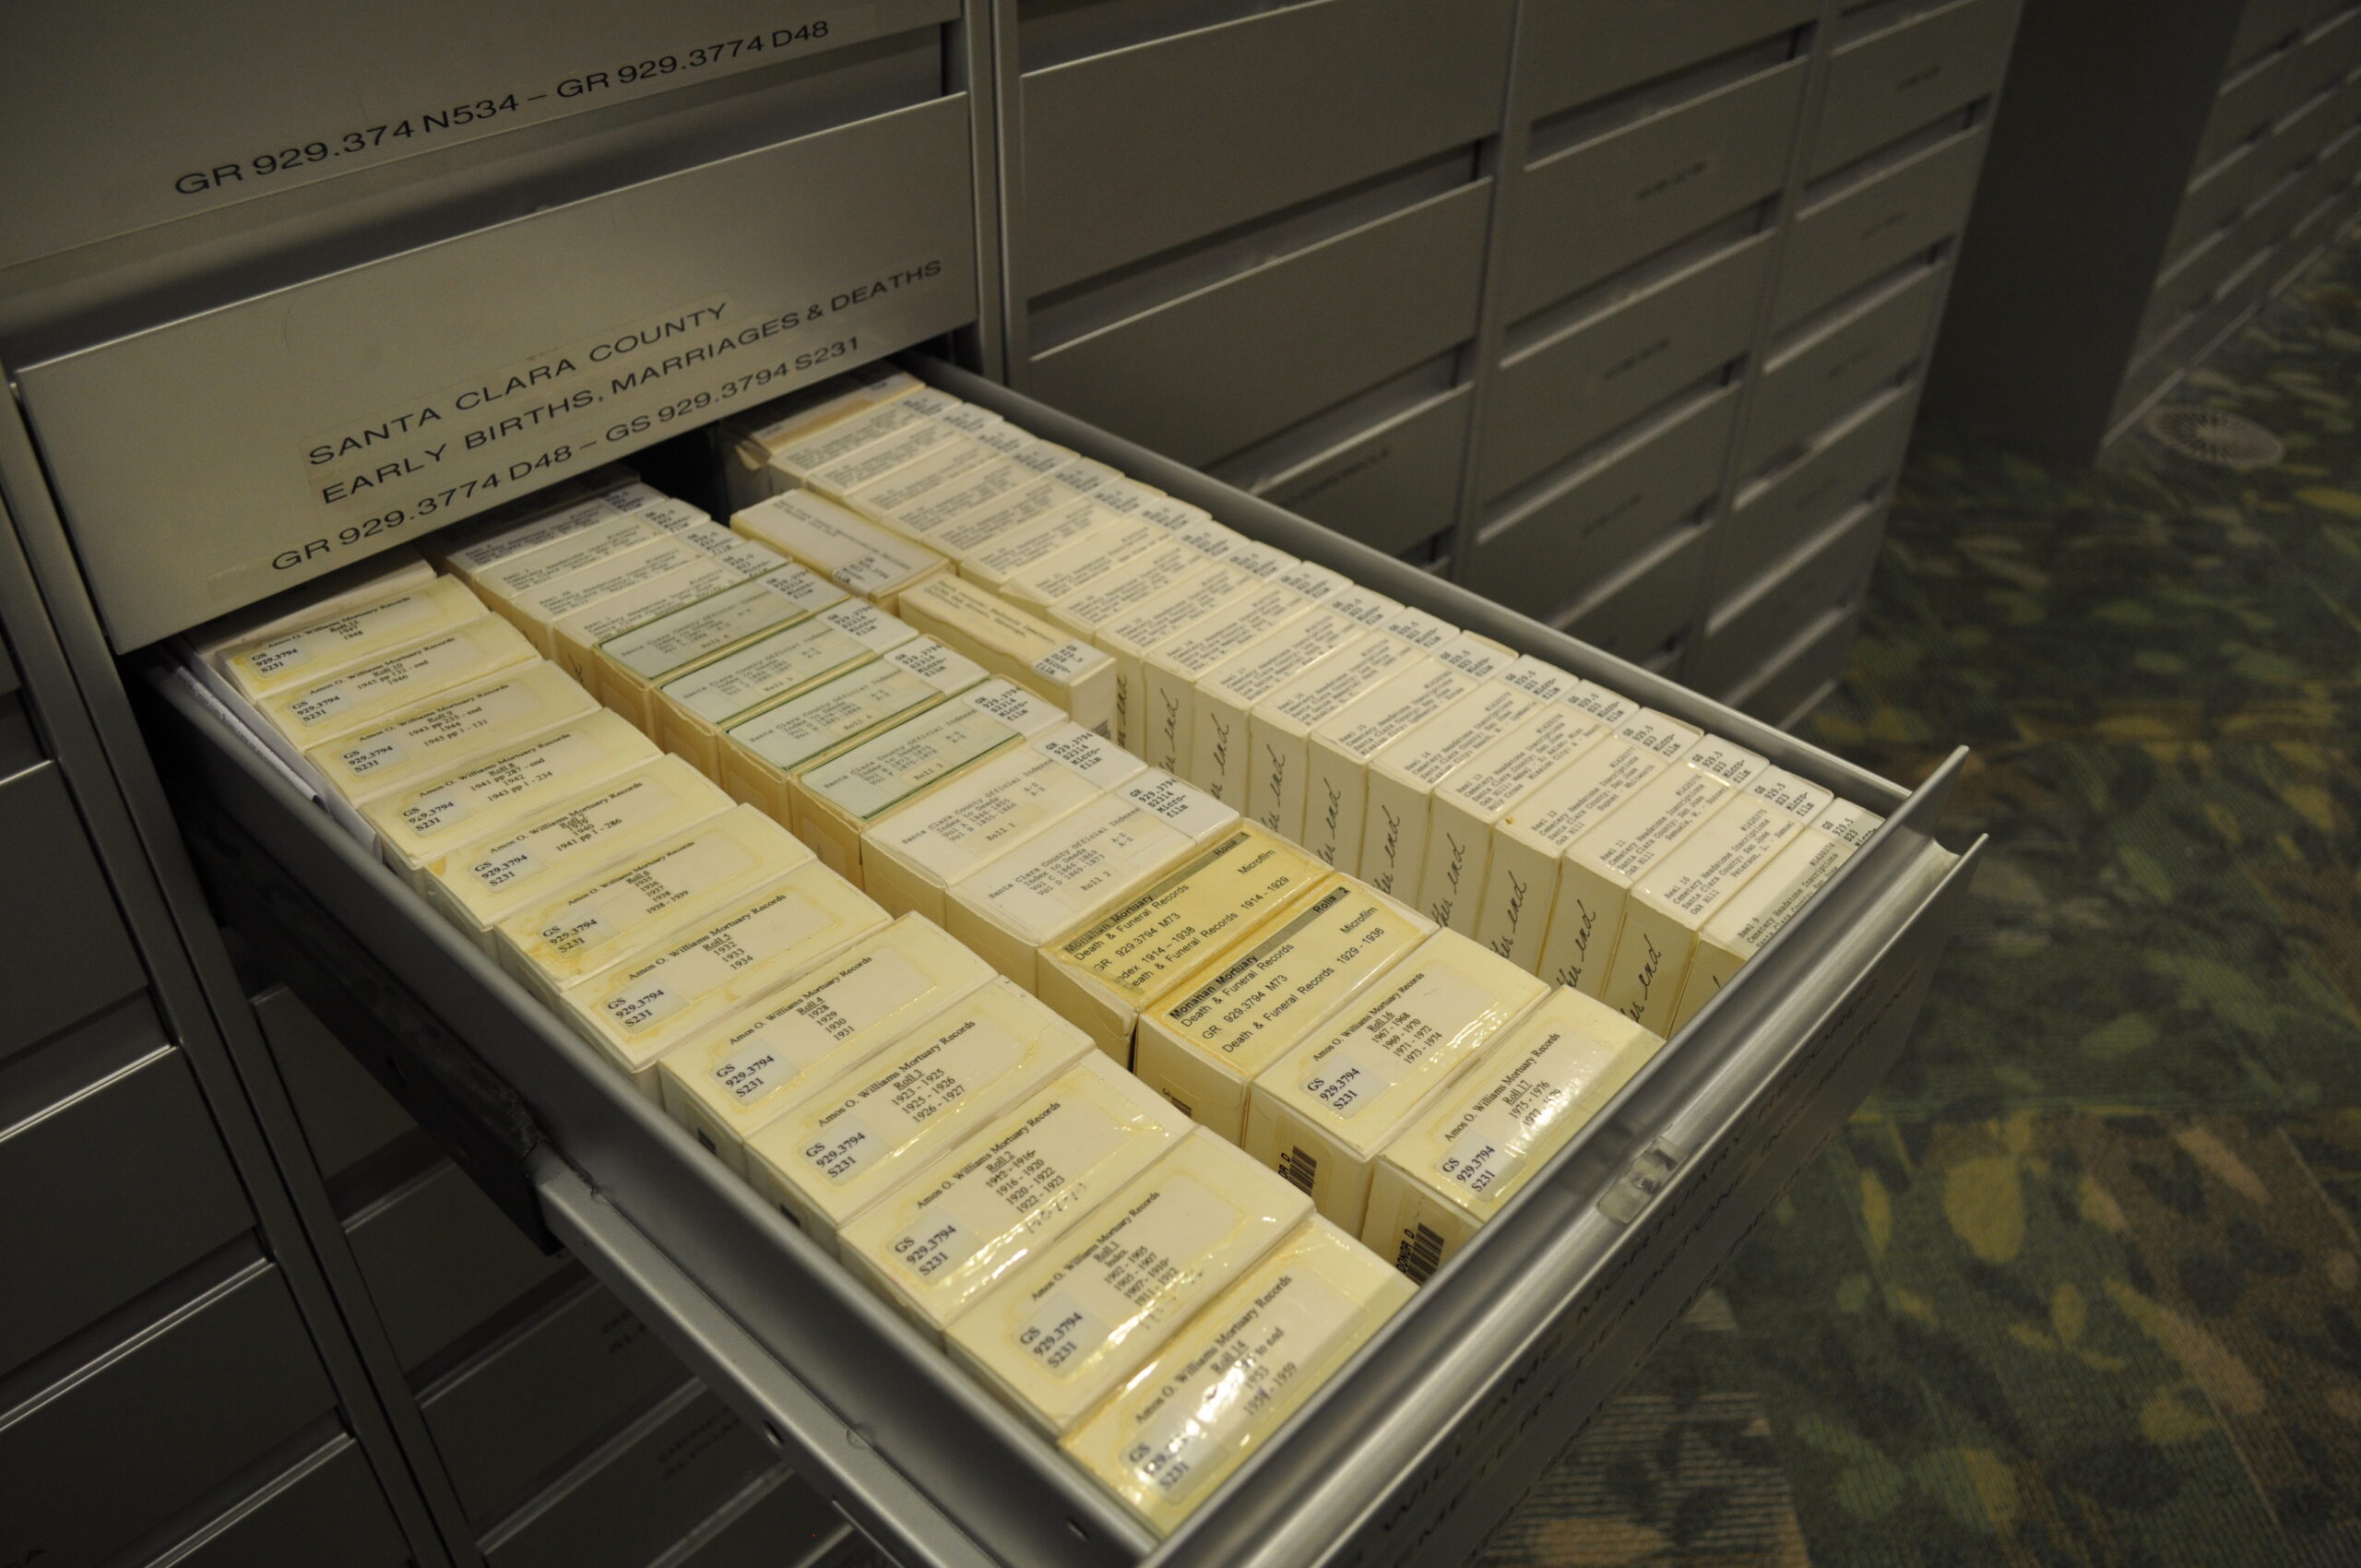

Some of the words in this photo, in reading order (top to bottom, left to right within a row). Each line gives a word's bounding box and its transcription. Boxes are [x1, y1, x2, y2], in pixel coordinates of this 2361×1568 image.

[174, 164, 243, 195] GR
[252, 120, 414, 175] 929.374
[421, 94, 519, 133] N534
[556, 73, 610, 98] GR
[618, 36, 764, 84] 929.3774
[772, 20, 829, 48] D48
[309, 408, 442, 465] SANTA
[456, 359, 576, 411] CLARA
[590, 303, 727, 362] COUNTY
[323, 444, 447, 505] EARLY
[465, 389, 603, 450] BIRTHS,
[611, 313, 800, 394] MARRIAGES
[806, 304, 824, 321] &
[831, 260, 942, 312] DEATHS
[271, 539, 331, 571] GR
[338, 473, 501, 546] 929.3774
[509, 445, 572, 481] D48
[605, 416, 651, 442] GS
[658, 362, 789, 423] 929.3794
[795, 337, 859, 372] S231
[252, 652, 267, 661] GS
[255, 647, 298, 667] 929.3794
[261, 661, 284, 673] S231
[1053, 733, 1094, 755] 929.3794
[1070, 747, 1100, 770] Micro-
[1080, 756, 1102, 772] film
[1129, 788, 1144, 799] GR
[1157, 794, 1187, 814] Micro-
[1785, 791, 1809, 814] Micro-
[1165, 802, 1189, 818] film
[1080, 875, 1102, 893] Roll
[1672, 881, 1703, 907] Cemetery
[1074, 941, 1104, 962] Death
[1108, 932, 1116, 941] &
[1117, 908, 1154, 935] Funeral
[1151, 883, 1190, 911] Records
[1238, 848, 1276, 875] Microfilm
[628, 964, 657, 980] Amos
[656, 957, 669, 966] O.
[669, 933, 710, 957] Williams
[709, 913, 752, 937] Mortuary
[751, 894, 787, 915] Records
[1064, 922, 1111, 955] Monahan
[1110, 893, 1154, 925] Mortuary
[1116, 925, 1158, 958] 929.3794
[1159, 912, 1181, 931] M73
[1155, 961, 1165, 971] &
[1165, 933, 1201, 964] Funeral
[1202, 910, 1239, 937] Records
[1240, 895, 1262, 911] 1914
[1268, 875, 1291, 895] 1929
[702, 937, 723, 952] Roll
[723, 932, 732, 941] 5
[713, 941, 737, 956] 1932
[722, 948, 746, 964] 1933
[1141, 948, 1164, 967] 1914
[1172, 926, 1197, 945] 1938
[1170, 984, 1215, 1020] Monahan
[1216, 954, 1259, 986] Mortuary
[1340, 886, 1349, 896] 2
[730, 955, 754, 970] 1934
[1181, 1005, 1211, 1028] Death
[1212, 996, 1222, 1006] &
[1223, 971, 1257, 1001] Funeral
[1257, 943, 1295, 973] Records
[1340, 907, 1378, 935] Microfilm
[607, 998, 627, 1011] GS
[615, 989, 665, 1019] 929.3794
[1202, 1023, 1222, 1039] GR
[1223, 990, 1266, 1025] 929.3794
[1266, 973, 1288, 992] M73
[1221, 1028, 1253, 1054] Death
[1254, 1018, 1264, 1029] &
[1264, 989, 1299, 1022] Funeral
[1299, 966, 1335, 995] Records
[1336, 945, 1358, 964] 1929
[1361, 927, 1385, 945] 1936
[625, 1009, 653, 1027] S231
[1312, 1046, 1333, 1063] Amos
[1332, 1037, 1342, 1047] O.
[1342, 1016, 1374, 1039] Williams
[1369, 992, 1402, 1021] Mortuary
[1398, 971, 1425, 993] Records
[1367, 1016, 1385, 1033] Roll
[1382, 1010, 1394, 1019] 16
[1372, 1028, 1391, 1044] 1967
[1394, 1012, 1411, 1028] 1968
[1382, 1034, 1401, 1051] 1969
[1405, 1017, 1422, 1034] 1970
[1393, 1040, 1411, 1058] 1971
[1417, 1024, 1434, 1041] 1972
[1403, 1048, 1422, 1064] 1973
[1426, 1030, 1444, 1049] 1974
[817, 1108, 847, 1129] Amos
[845, 1097, 860, 1109] O.
[858, 1070, 900, 1099] Williams
[898, 1043, 942, 1077] Mortuary
[940, 1019, 977, 1045] Records
[892, 1090, 912, 1106] 1923
[921, 1068, 945, 1085] 1925
[893, 1076, 913, 1092] Roll
[1306, 1077, 1325, 1093] GS
[1319, 1066, 1361, 1102] 929.3794
[1444, 1123, 1463, 1143] Amos
[1464, 1110, 1478, 1125] O.
[1474, 1079, 1507, 1115] Williams
[1504, 1051, 1539, 1084] Mortuary
[1534, 1031, 1561, 1059] Records
[901, 1099, 924, 1115] 1925
[931, 1076, 956, 1094] 1926
[911, 1106, 936, 1123] 1926
[942, 1084, 966, 1101] 1927
[1333, 1089, 1358, 1111] S231
[1502, 1086, 1522, 1106] Roll
[1519, 1078, 1531, 1091] 17
[1508, 1099, 1527, 1120] 1975
[1531, 1080, 1550, 1099] 1976
[805, 1142, 825, 1158] GS
[815, 1131, 866, 1168] 929.3794
[1455, 1144, 1497, 1183] 929.3794
[827, 1155, 856, 1179] S231
[1442, 1156, 1461, 1175] GS
[1470, 1169, 1497, 1193] S231
